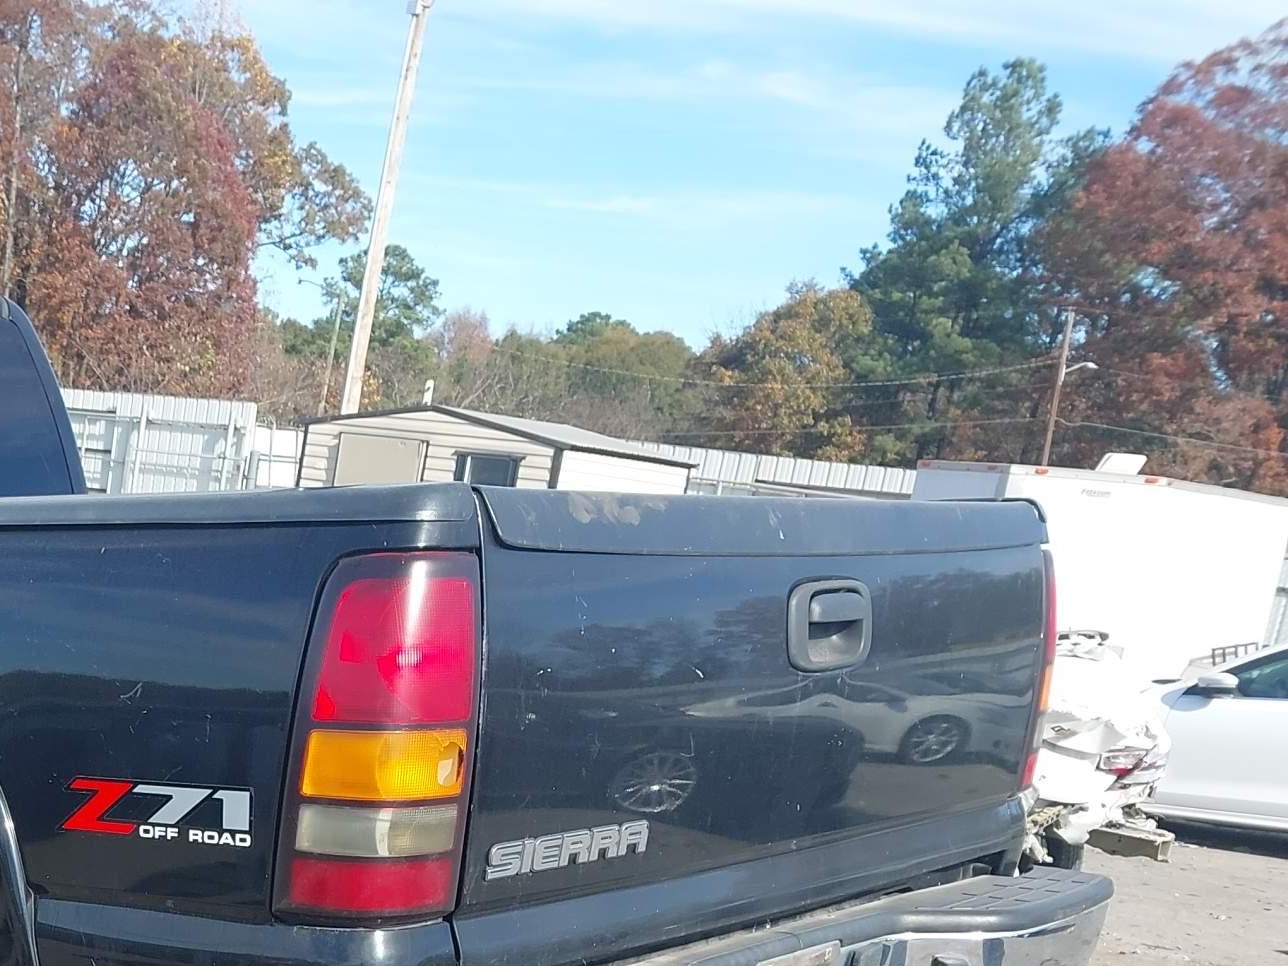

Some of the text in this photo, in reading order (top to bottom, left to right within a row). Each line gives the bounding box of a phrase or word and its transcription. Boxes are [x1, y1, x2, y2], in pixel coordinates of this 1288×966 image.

[63, 778, 251, 835] Z71
[138, 825, 251, 847] OFF ROAD
[485, 819, 650, 881] SIERRA
